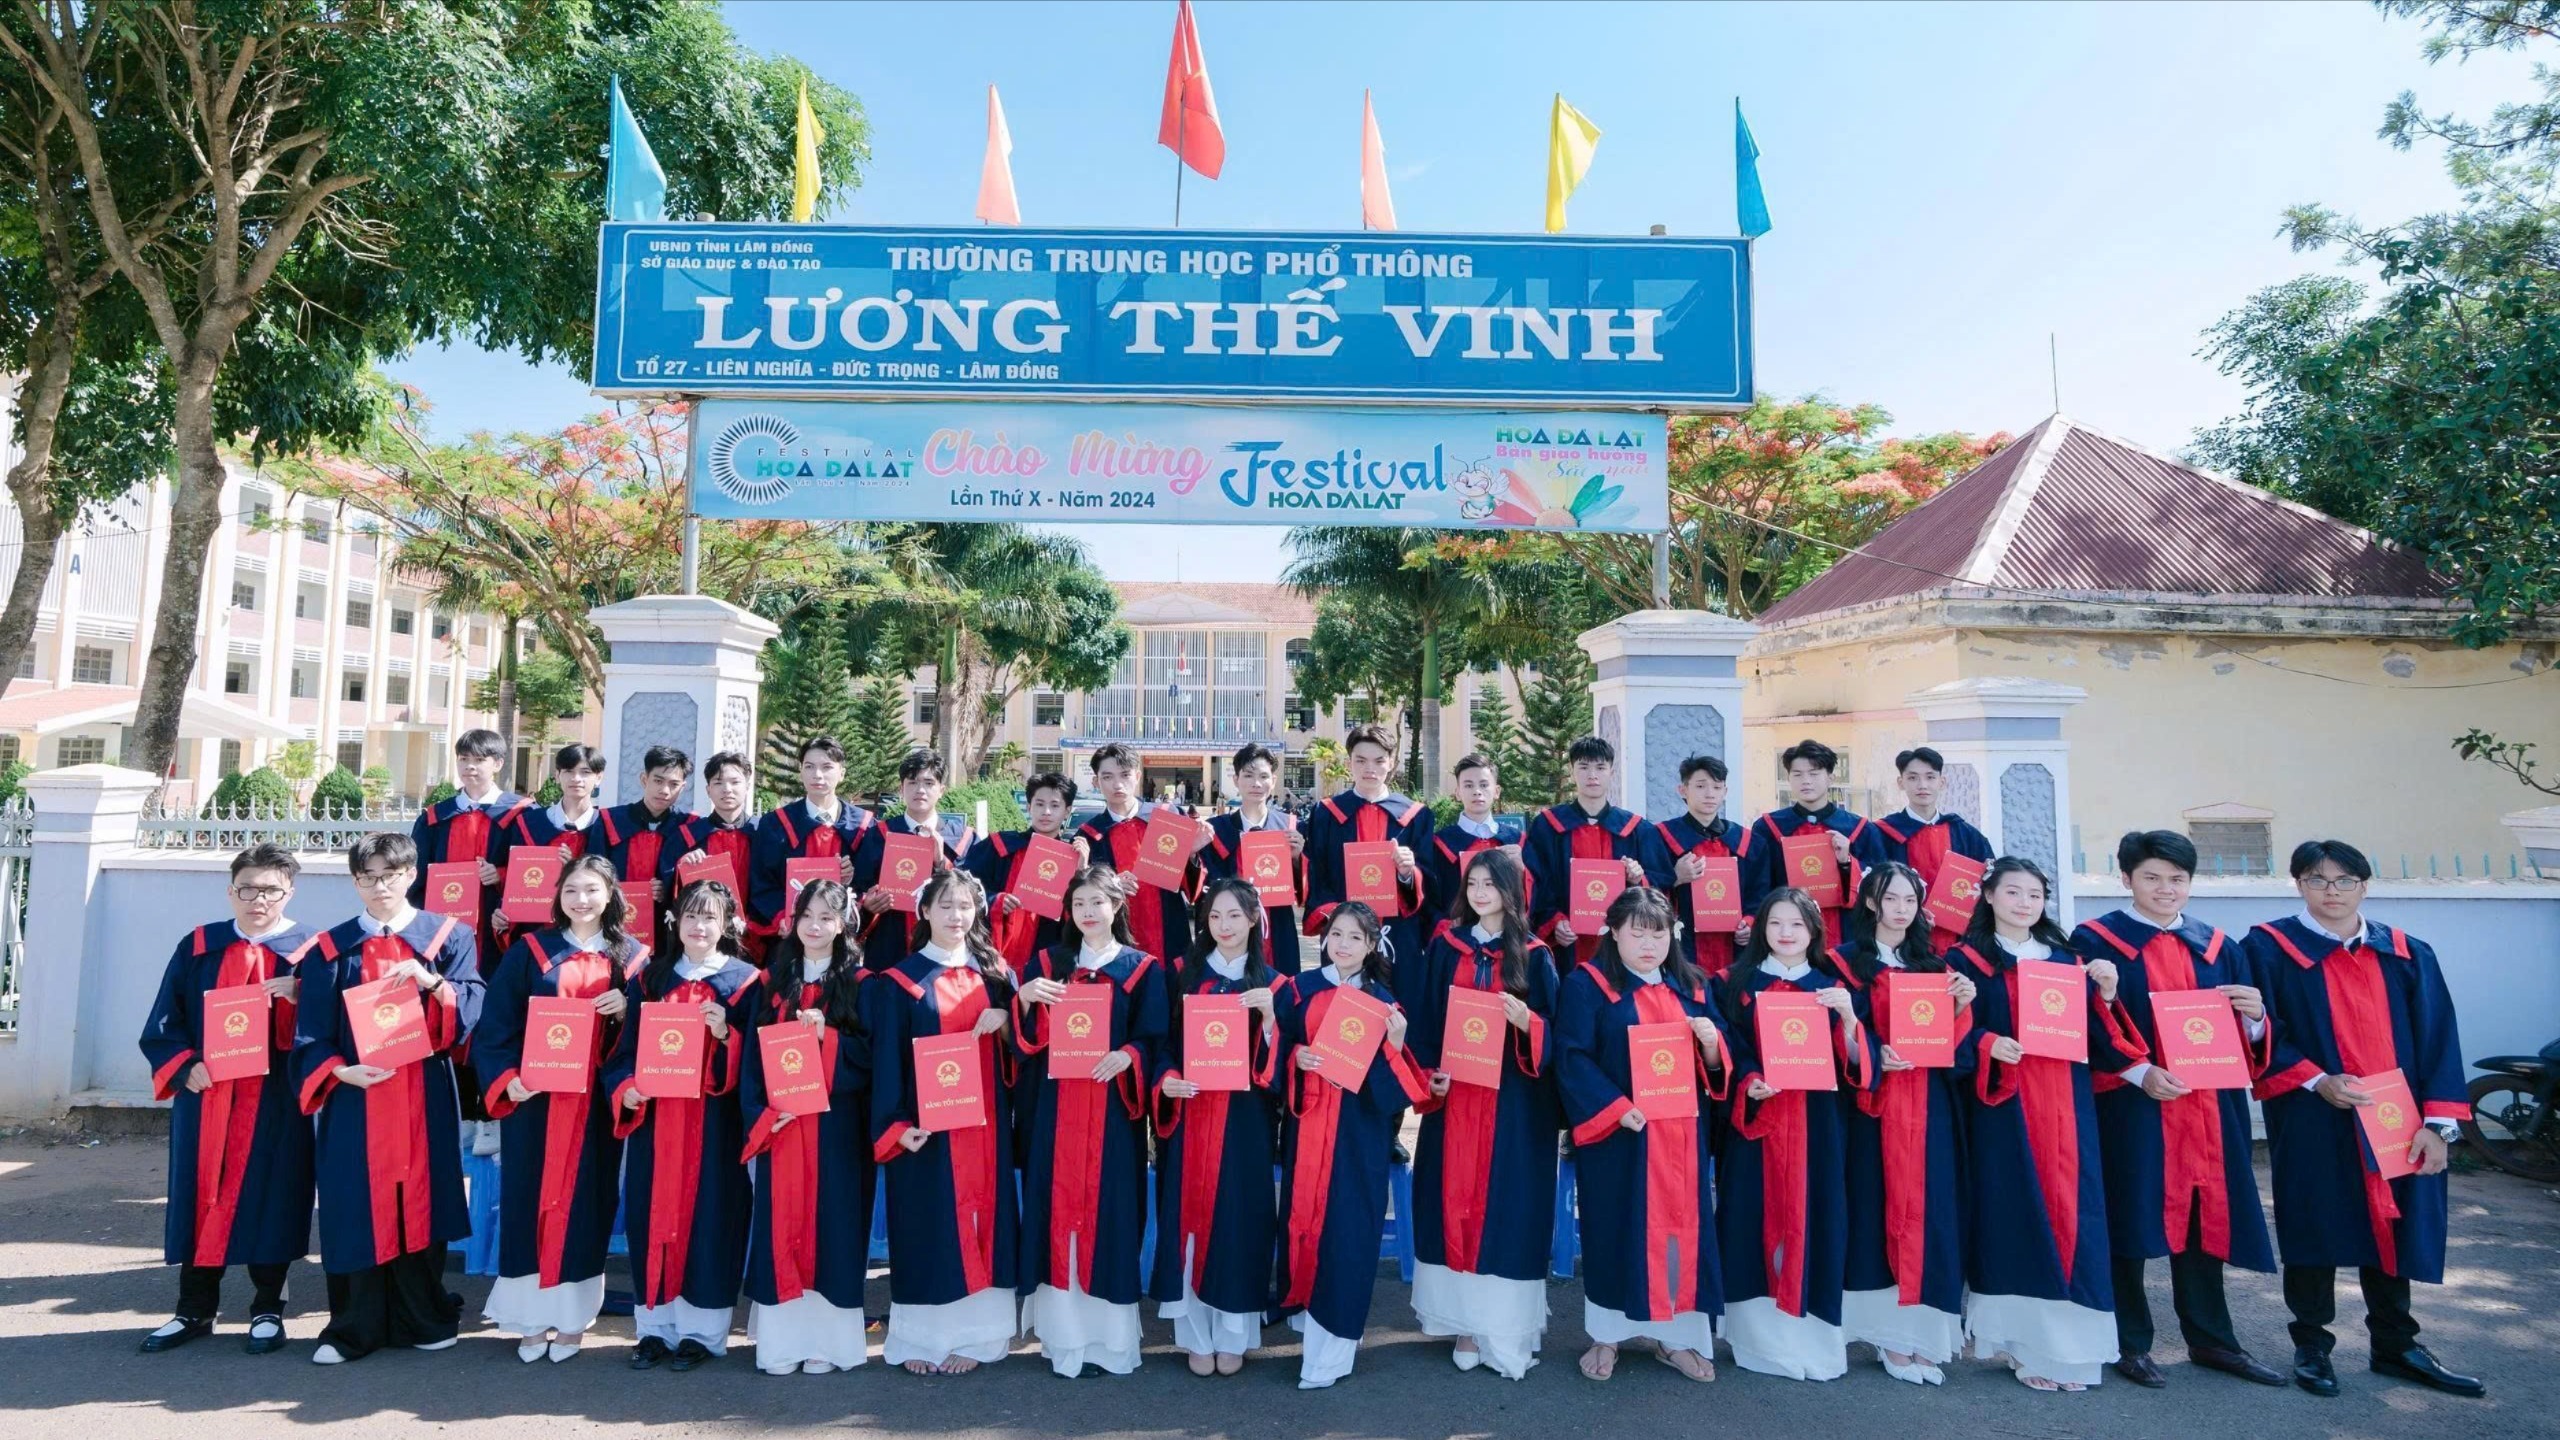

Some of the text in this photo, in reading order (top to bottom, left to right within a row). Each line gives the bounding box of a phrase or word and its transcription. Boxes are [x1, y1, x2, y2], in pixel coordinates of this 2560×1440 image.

[650, 239, 813, 253] UBND TỈNH LÂM ĐỒNG
[641, 255, 820, 270] SỞ GIÁO DỤC & ĐÀO TẠO
[887, 242, 1473, 279] TRƯỜNG TRUNG HỌC PHỔ THÔNG
[694, 278, 1664, 362] LƯƠNG THẾ VINH
[636, 358, 660, 375] TỔ
[664, 360, 688, 375] 27
[706, 358, 748, 376] LIÊN
[753, 359, 814, 376] NGHĨA
[832, 360, 870, 378] ĐỨC
[877, 362, 940, 381] TRỌNG
[959, 360, 1000, 380] LÂM
[1005, 360, 1059, 380] ĐỒNG
[1496, 426, 1550, 444] HOA
[1598, 430, 1645, 450] LẠT
[758, 448, 914, 458] FESTIVAL
[924, 428, 1214, 495] Chào Mừng
[1539, 447, 1580, 462] giao
[756, 460, 814, 476] HOA
[1219, 441, 1448, 508] Festival
[951, 484, 983, 506] Lần
[990, 489, 1024, 506] Thứ
[1028, 490, 1041, 506] X
[1059, 490, 1103, 508] Năm
[1110, 492, 1156, 508] 2024
[1268, 490, 1406, 510] HOA DALAT
[70, 554, 80, 574] A
